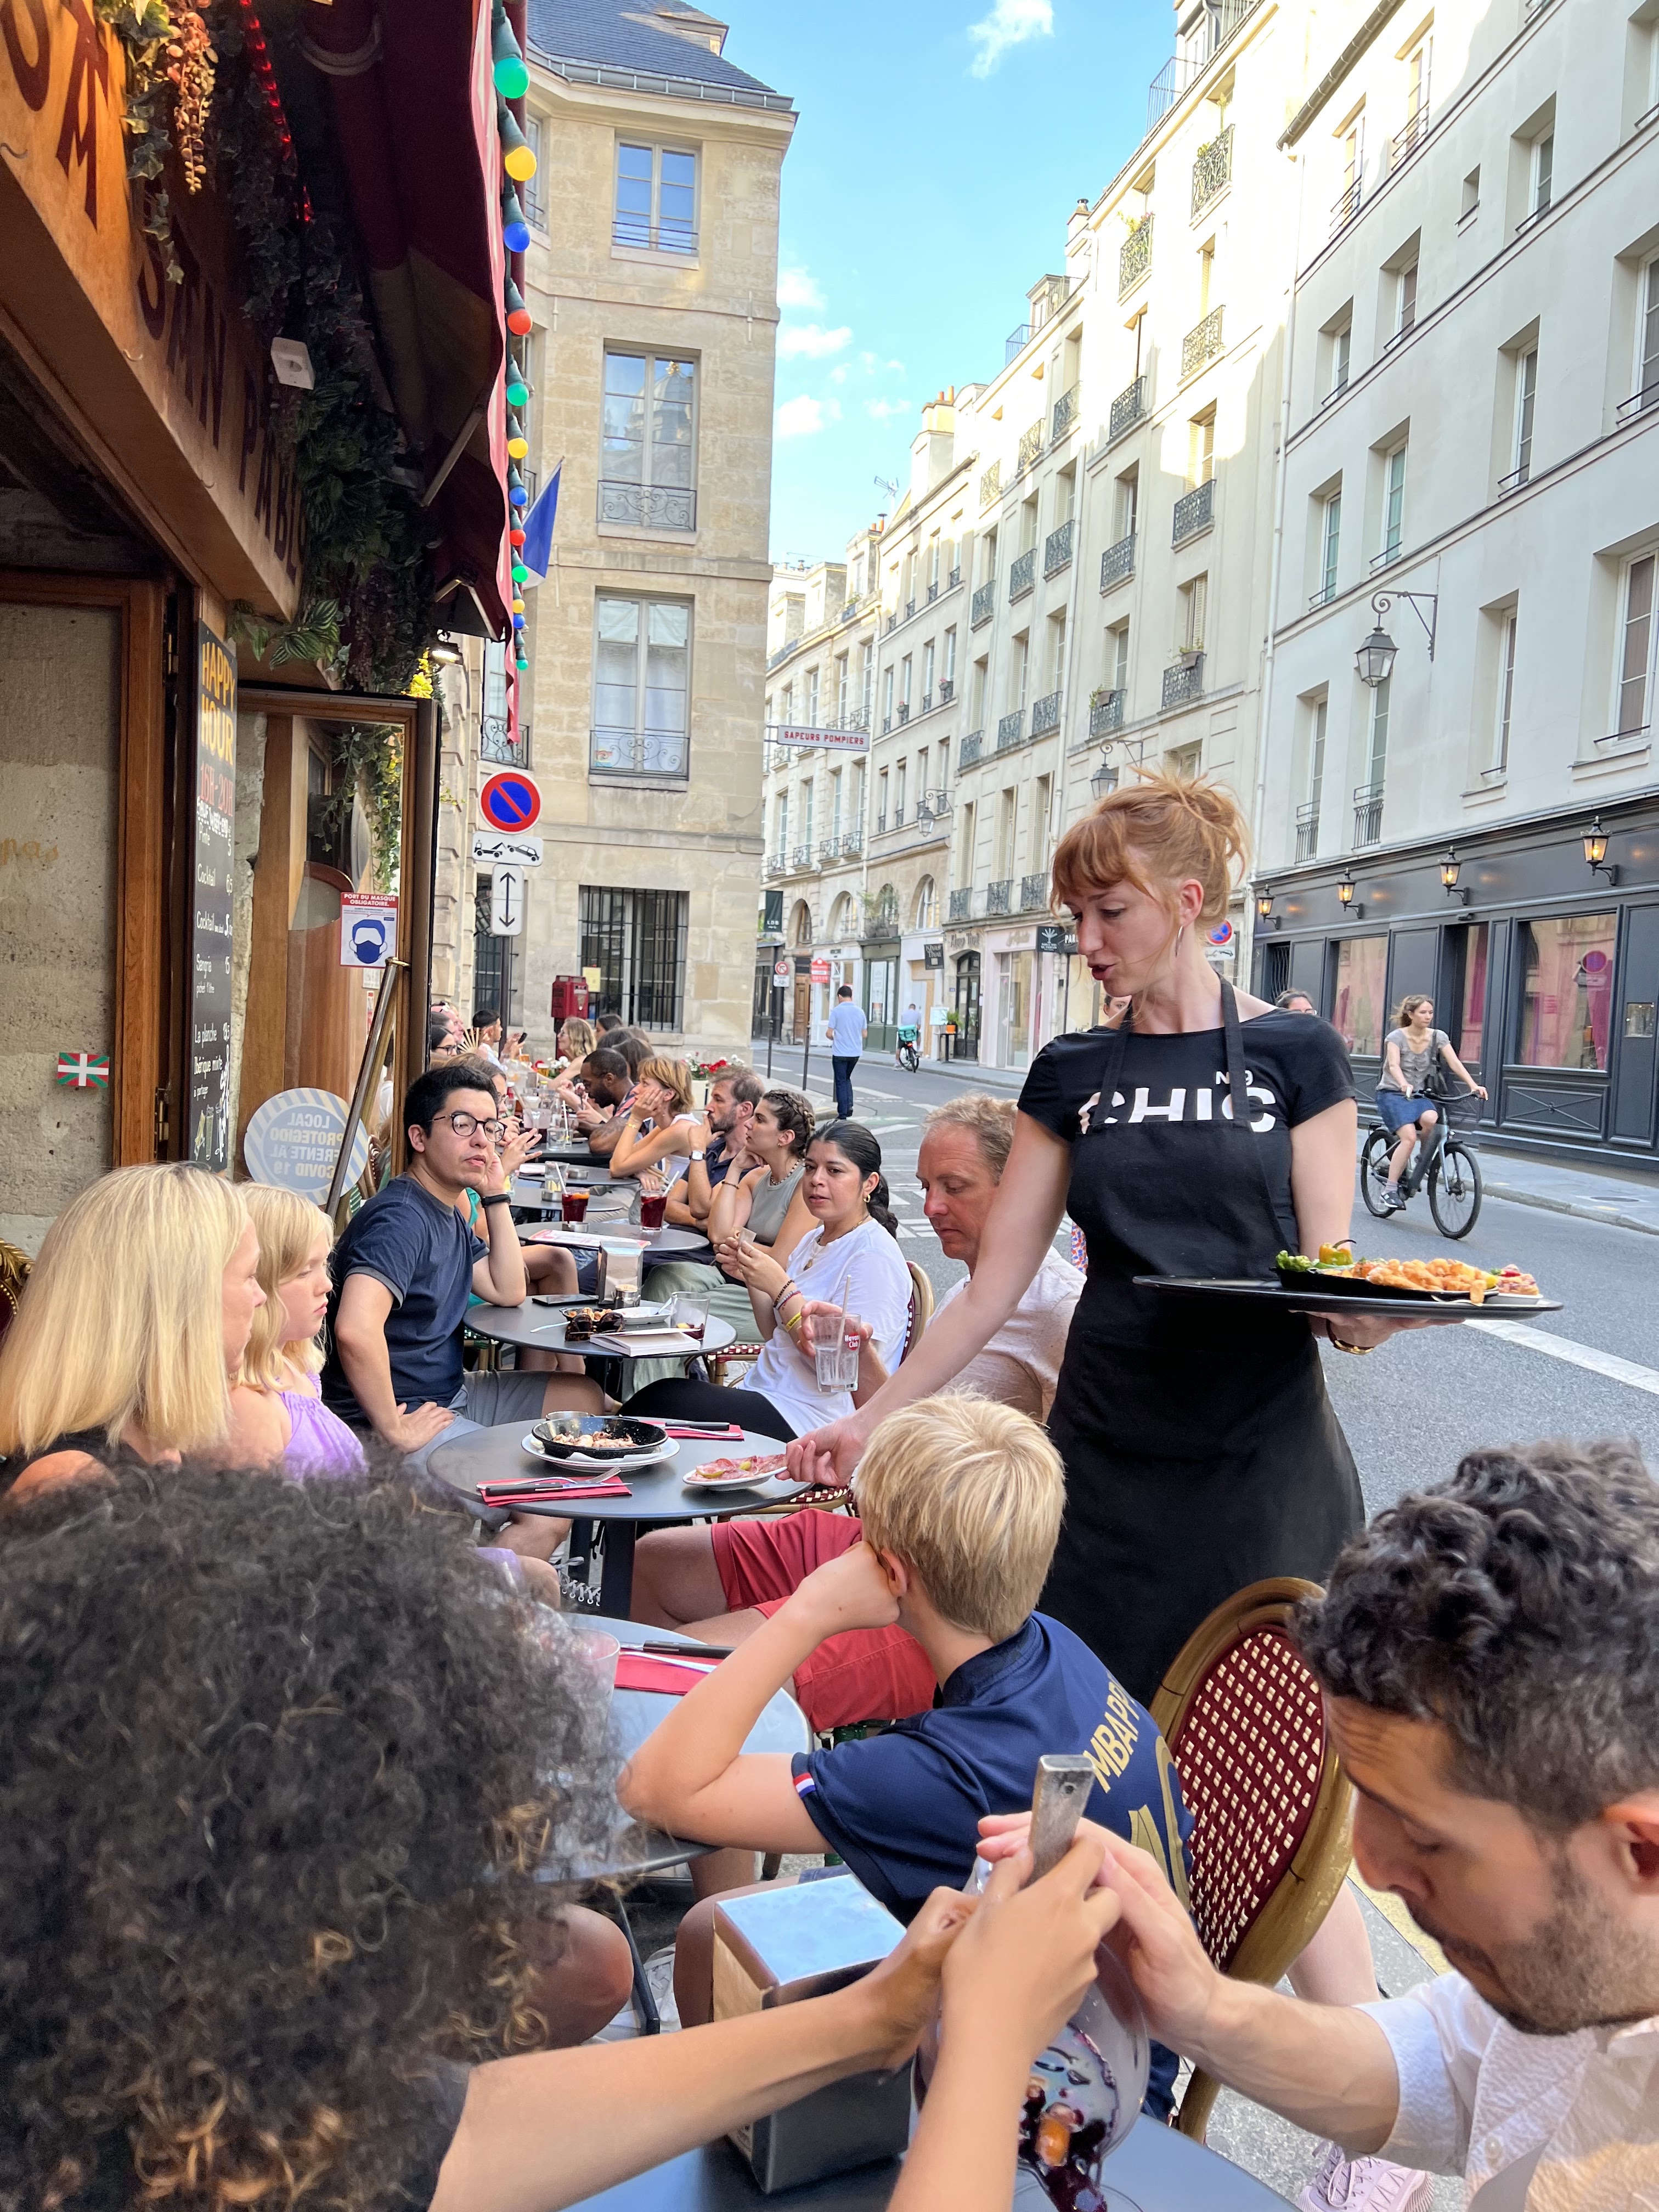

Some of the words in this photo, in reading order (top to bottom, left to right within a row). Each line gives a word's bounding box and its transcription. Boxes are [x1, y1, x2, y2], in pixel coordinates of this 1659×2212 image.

[202, 641, 235, 712] HAPPY
[201, 693, 233, 766] HOUR
[785, 731, 820, 741] SAPEURS
[824, 735, 864, 745] POMPIERS
[198, 863, 216, 887] Cocktail
[196, 911, 215, 931] Cocktail
